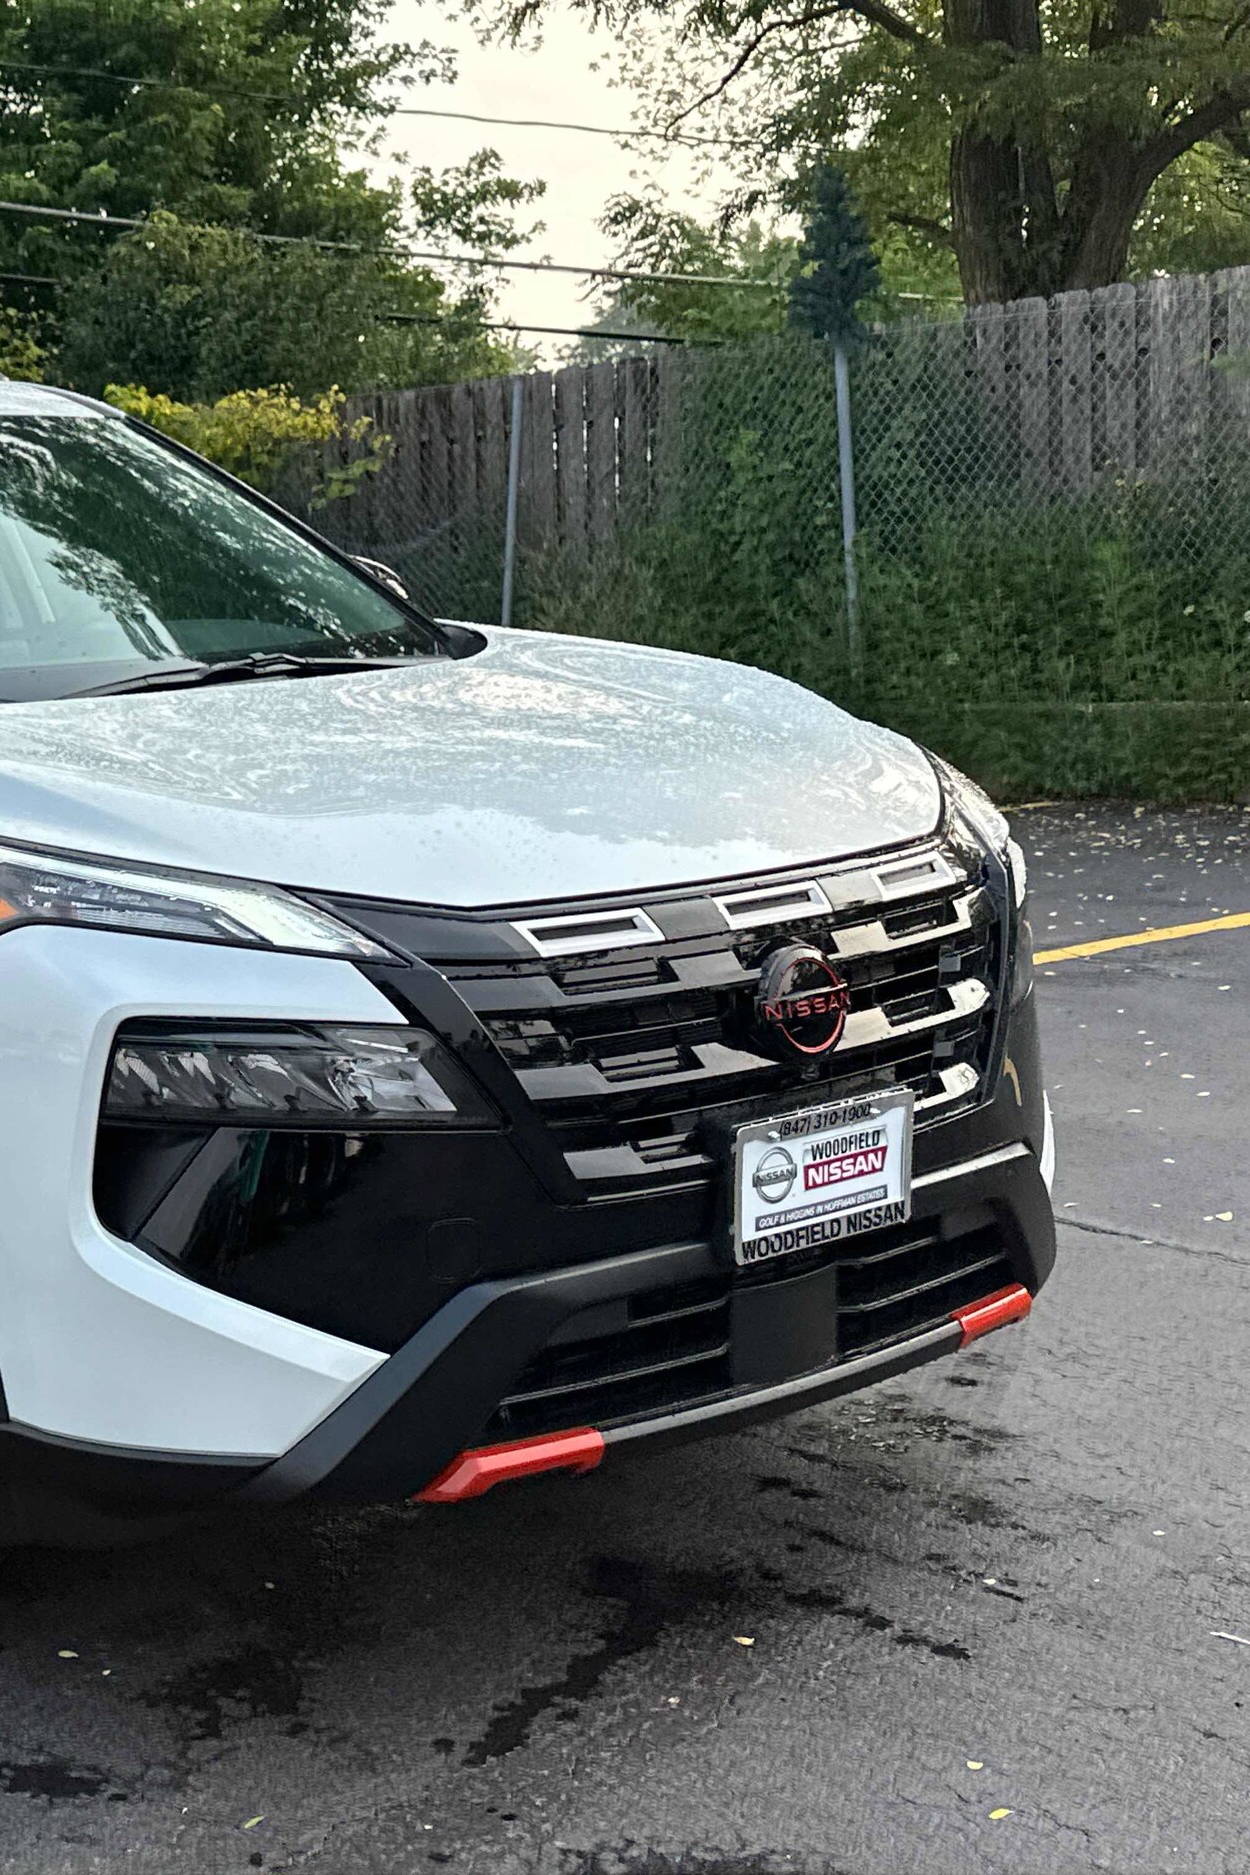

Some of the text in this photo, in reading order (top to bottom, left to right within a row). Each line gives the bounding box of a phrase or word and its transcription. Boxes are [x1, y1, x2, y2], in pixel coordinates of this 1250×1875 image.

[764, 990, 851, 1021] NISSAN
[813, 1102, 872, 1131] 310-1900
[811, 1129, 881, 1162] WOODFIELD
[756, 1167, 794, 1183] NISSAN
[807, 1150, 883, 1187] NISSAN
[742, 1201, 906, 1261] WOODFIELD NISSAN
